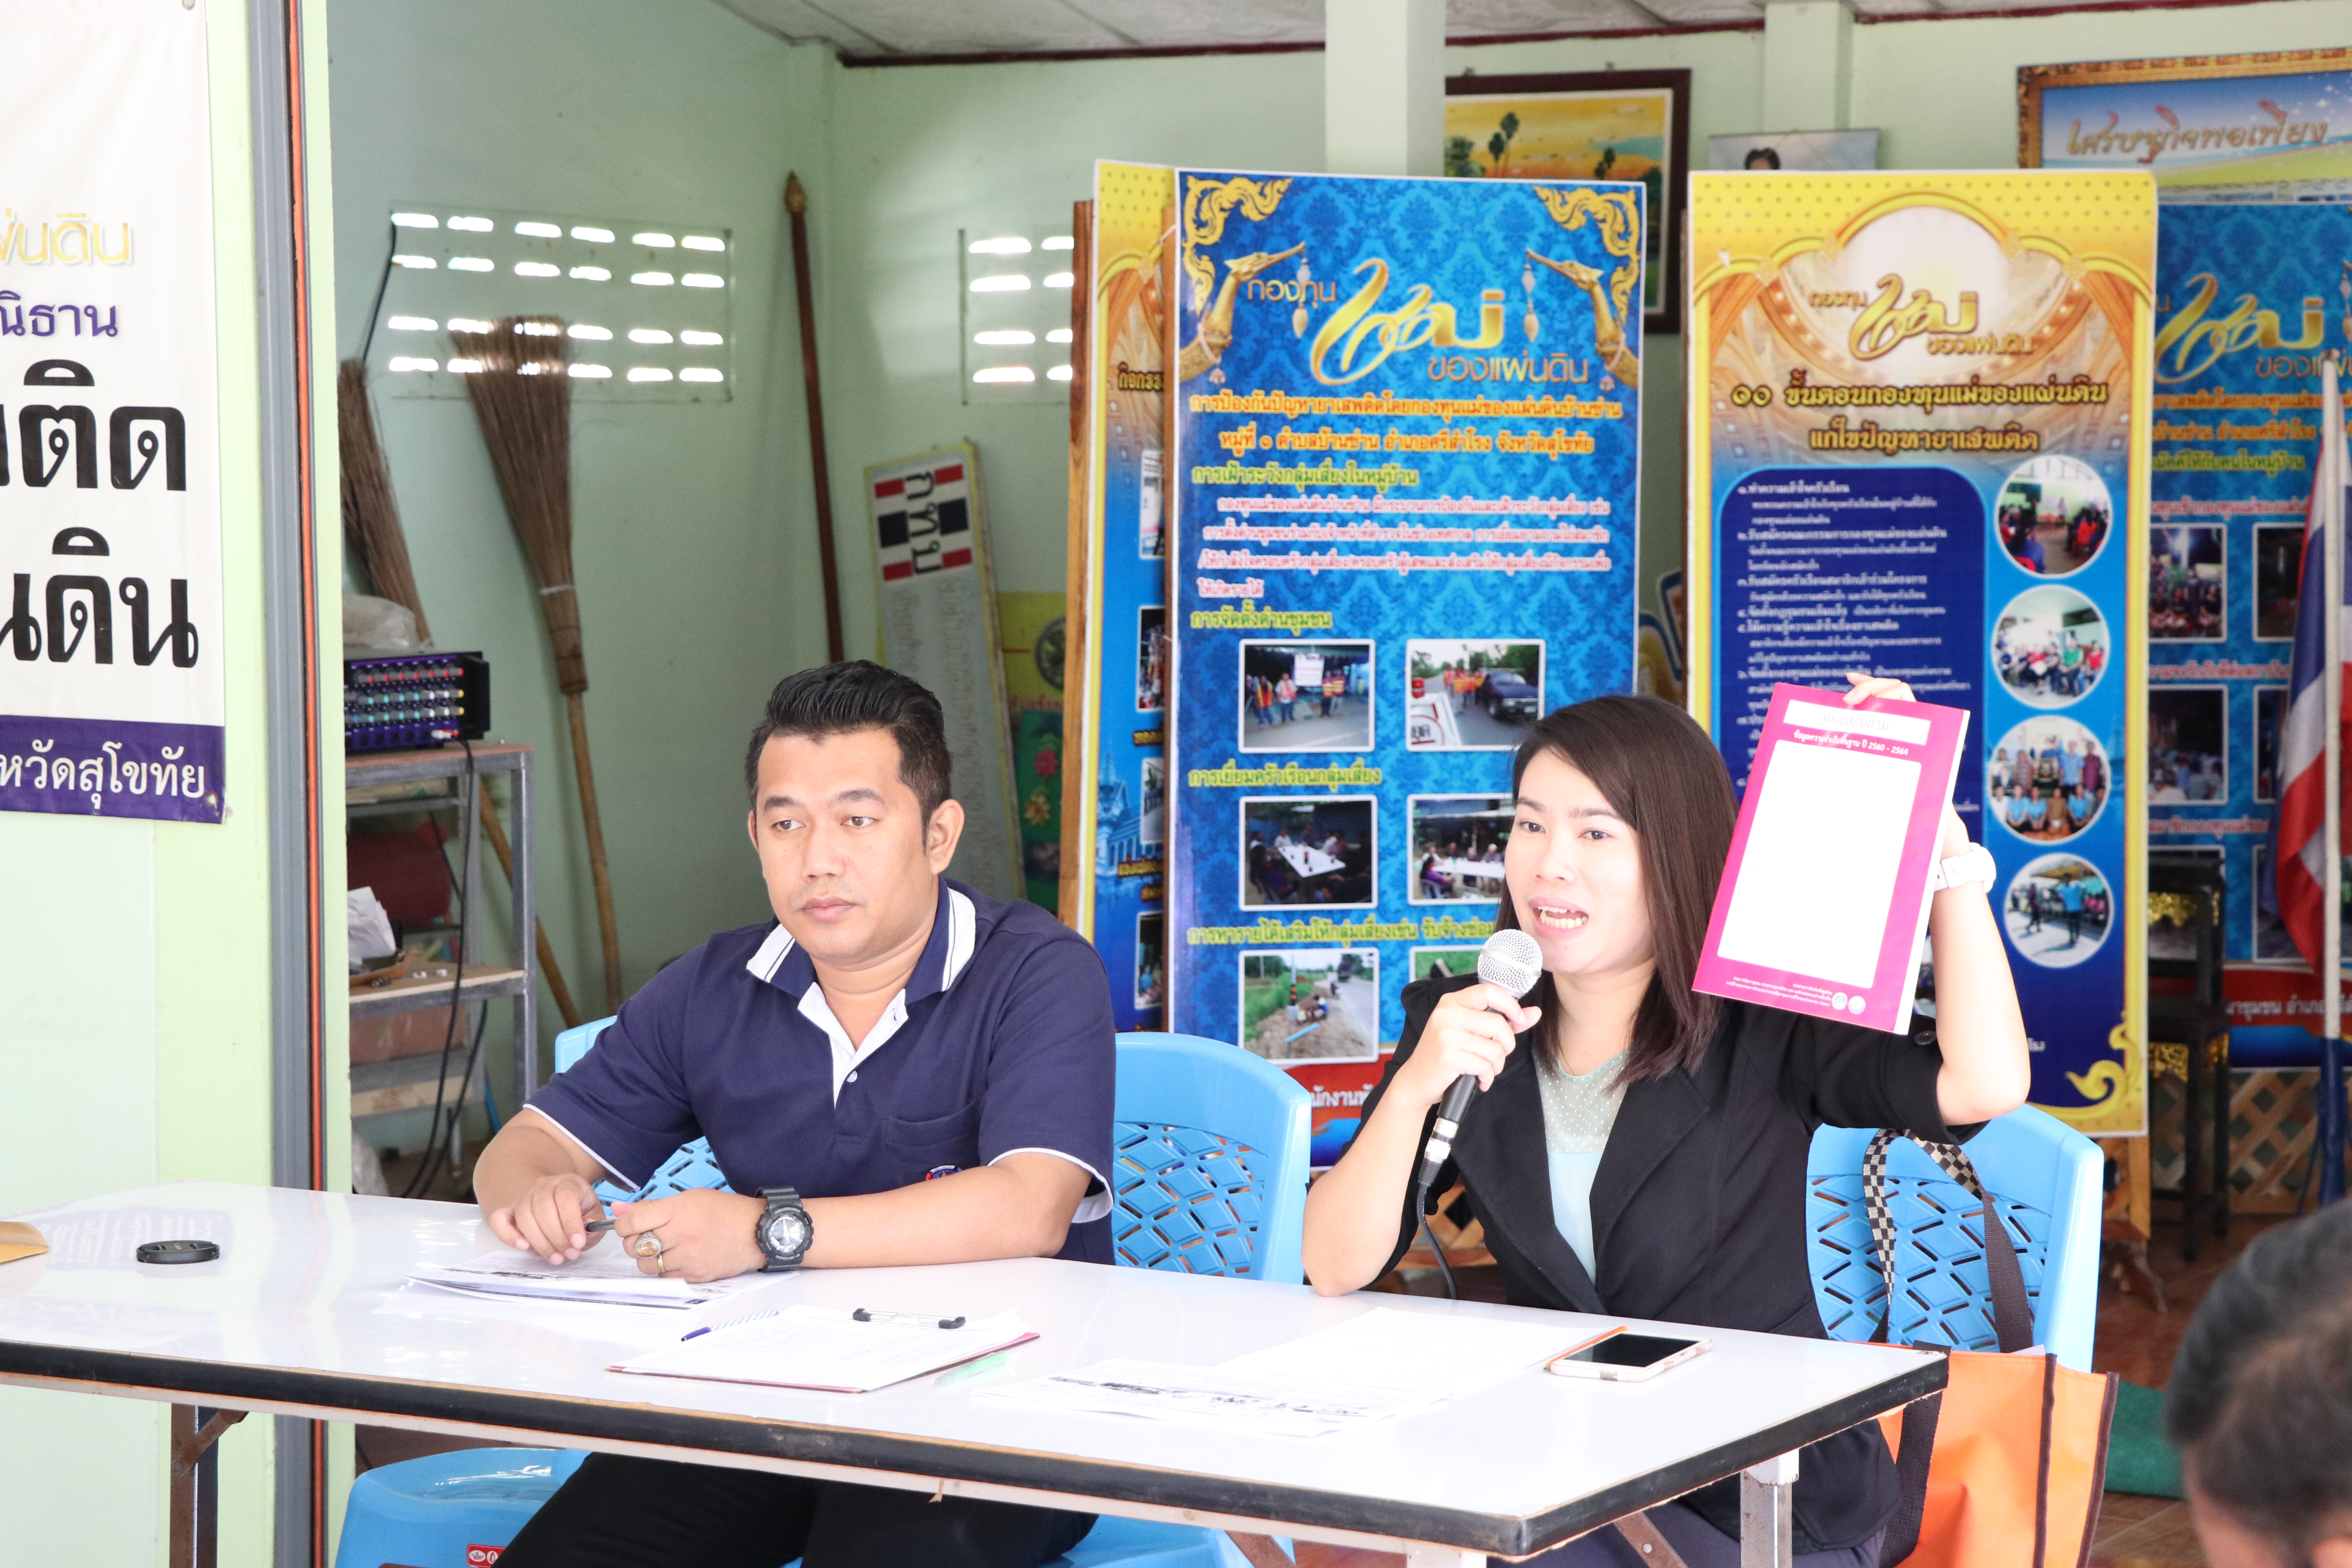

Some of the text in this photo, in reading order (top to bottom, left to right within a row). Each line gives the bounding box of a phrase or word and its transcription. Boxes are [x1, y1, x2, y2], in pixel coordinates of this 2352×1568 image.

[2067, 99, 2328, 163] เศรษฐกิจพอเพียง
[1247, 278, 1337, 308] กองทุน
[1118, 361, 1163, 390] กิจกรร
[1427, 350, 1588, 383] ของแผ่นดิน
[0, 358, 187, 492] ติด
[1809, 416, 2040, 455] แก้ไขปัญหายาเสพติด
[1823, 714, 1889, 731] แบบสอบถาม
[1794, 729, 1860, 748] ข้อมูลความจำเป็นพื้นฐาน
[1861, 739, 1868, 748] ปี
[1868, 742, 1885, 751] 2560
[1891, 746, 1909, 756] 2564
[0, 739, 205, 810] หวัดสุโขทัย
